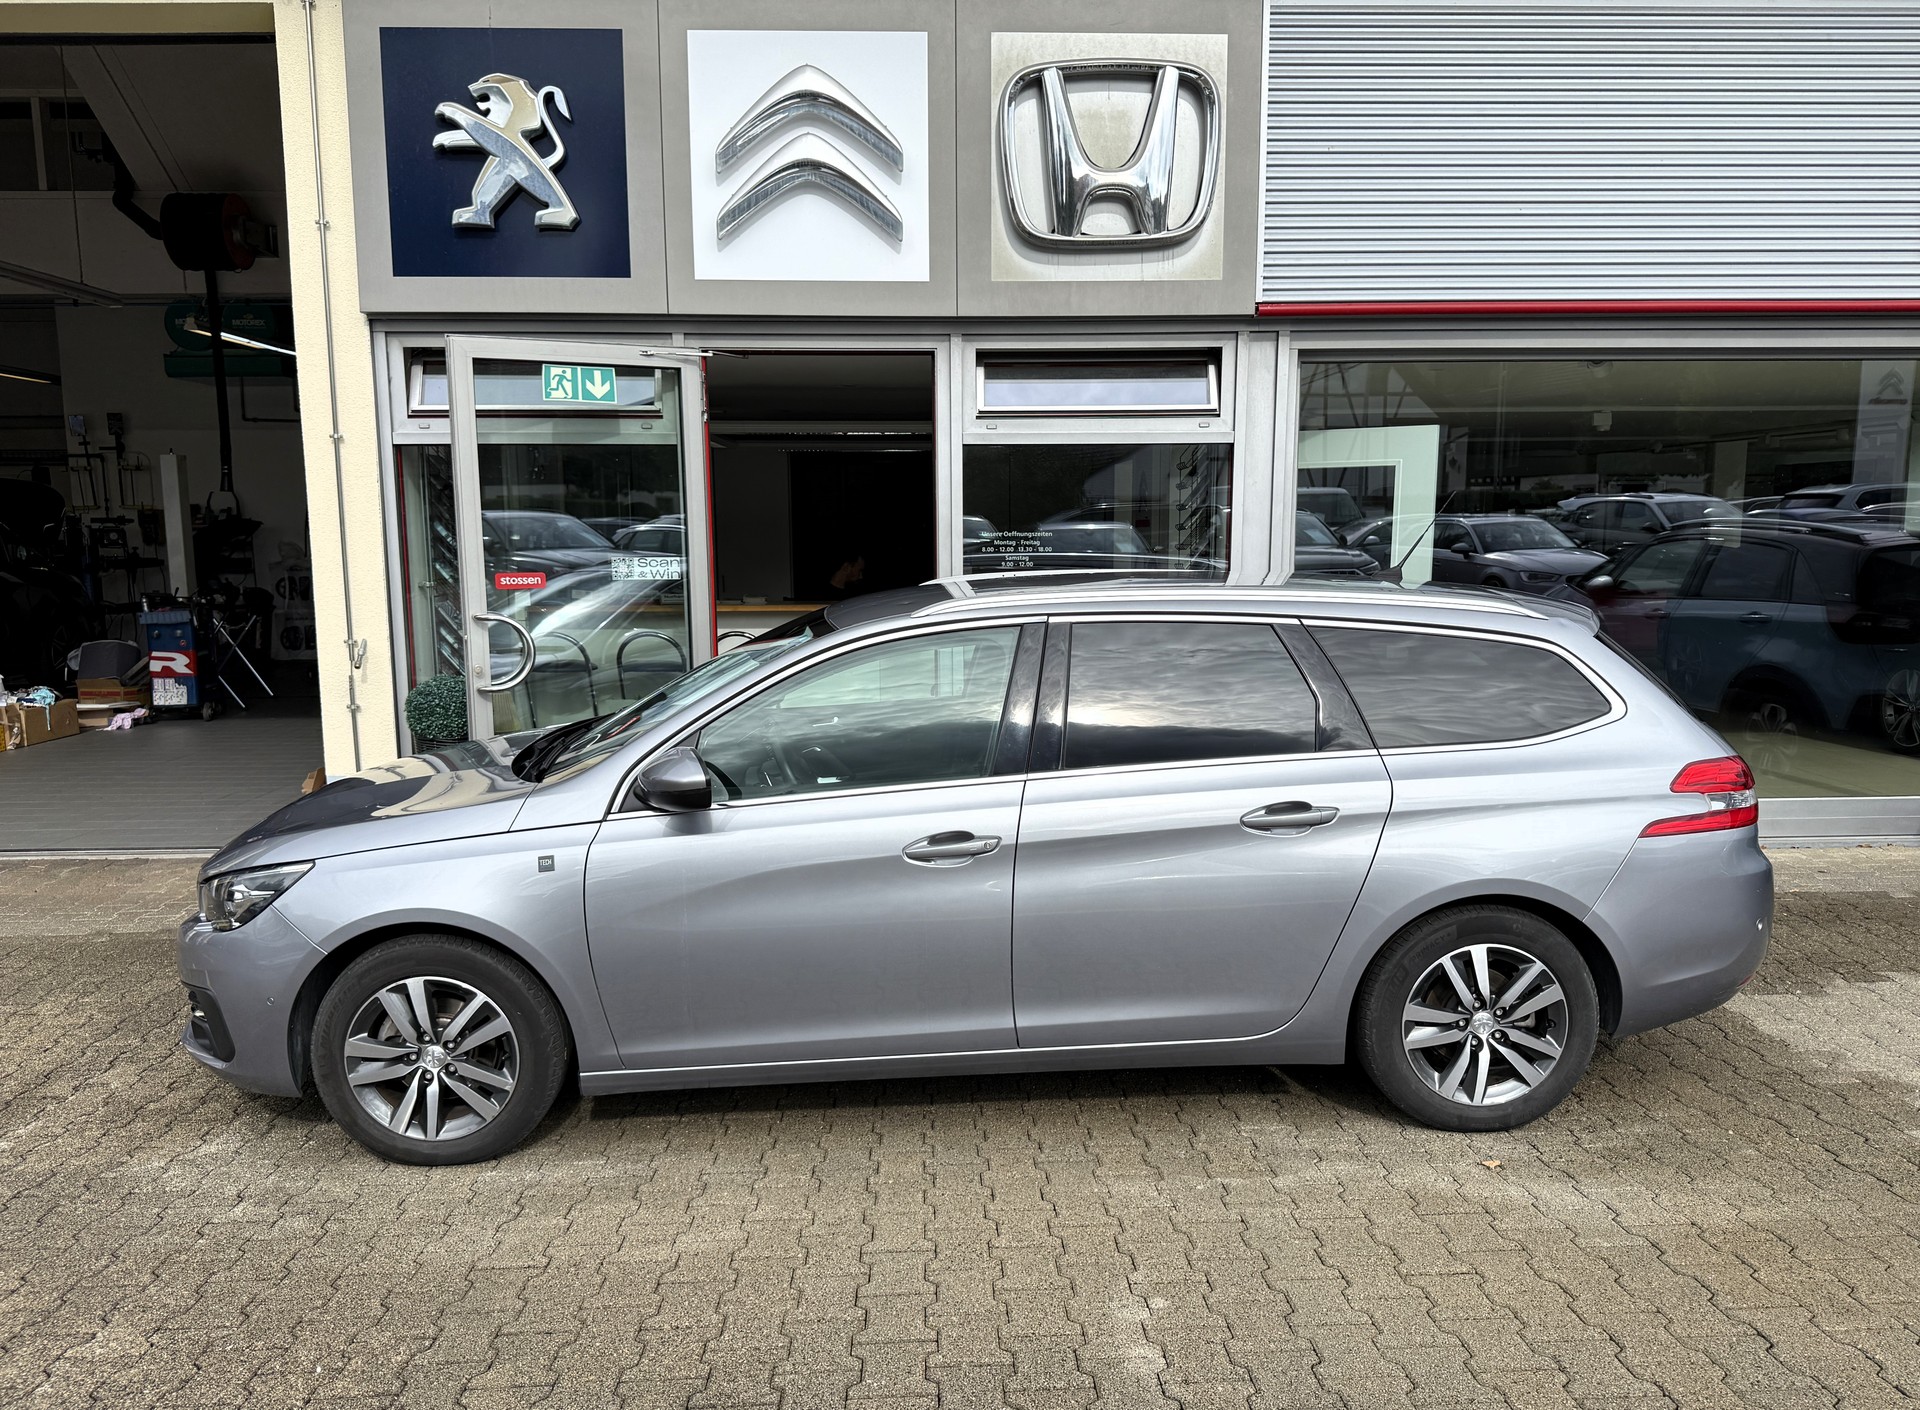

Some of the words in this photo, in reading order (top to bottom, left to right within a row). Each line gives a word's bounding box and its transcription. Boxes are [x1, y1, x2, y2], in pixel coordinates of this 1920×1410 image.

[637, 557, 680, 568] Scan
[638, 570, 648, 579] &
[650, 568, 680, 579] Win
[500, 576, 542, 585] stossen
